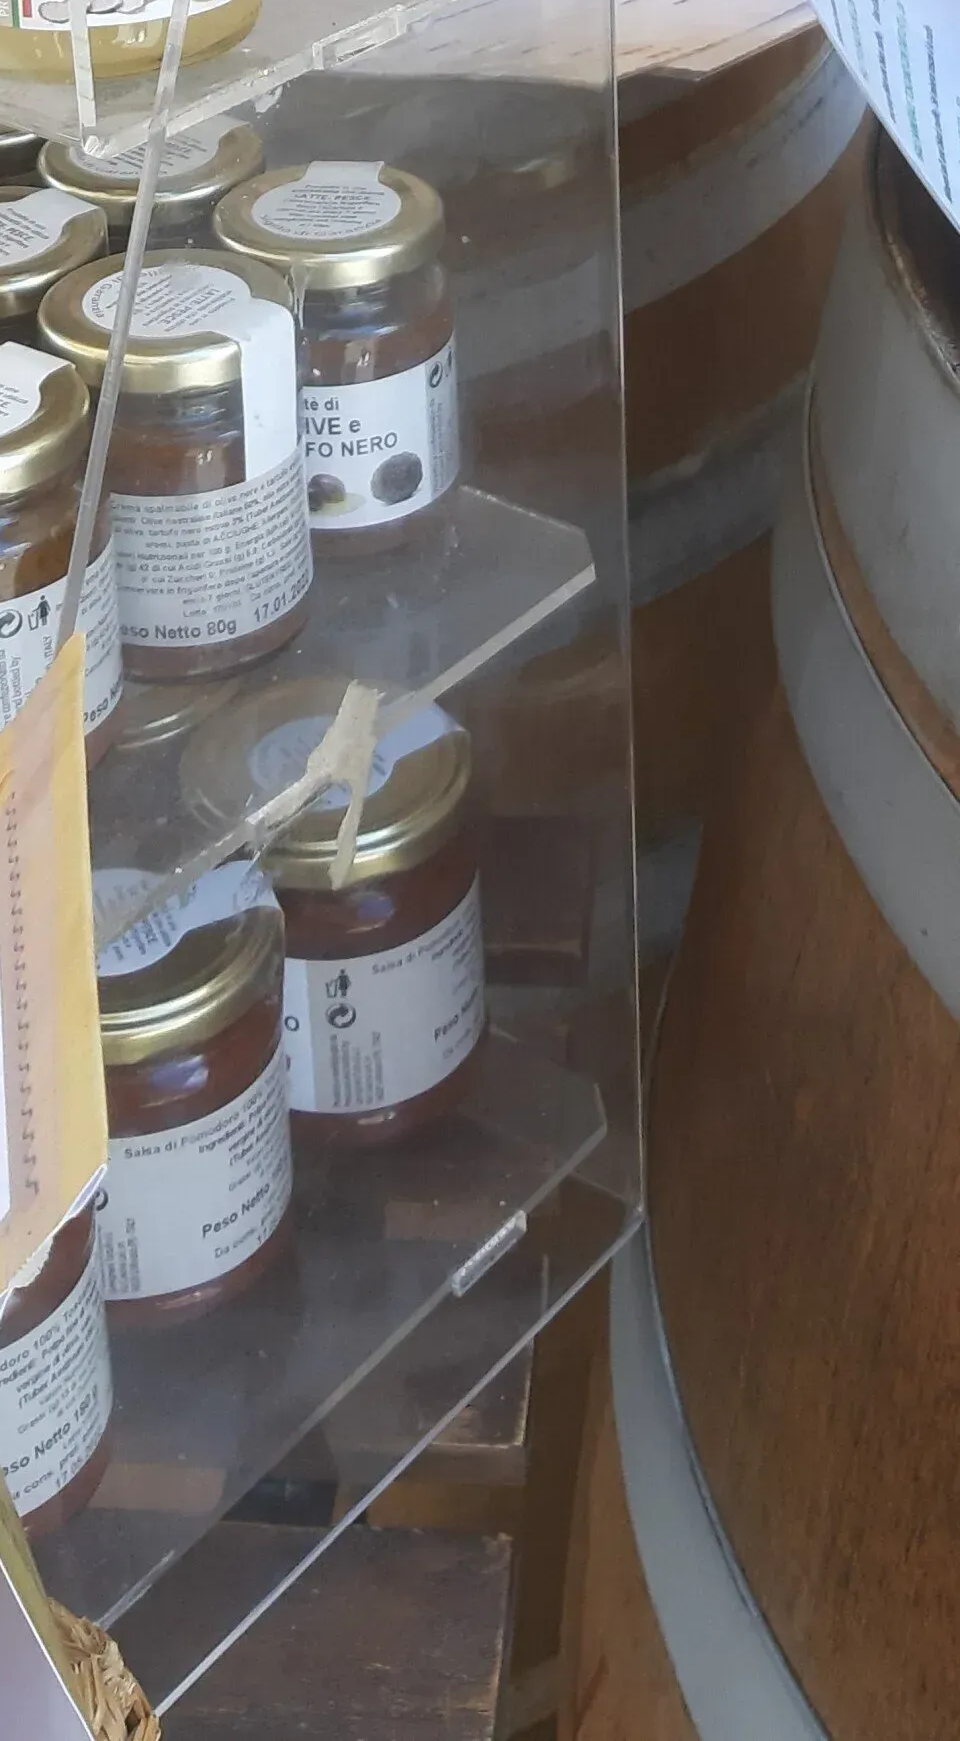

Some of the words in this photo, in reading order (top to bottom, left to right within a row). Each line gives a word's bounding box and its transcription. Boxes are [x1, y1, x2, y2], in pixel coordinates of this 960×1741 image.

[324, 396, 340, 411] di
[348, 419, 361, 433] e
[340, 432, 398, 458] NERO
[154, 623, 201, 640] Netto
[206, 618, 237, 636] 80g
[124, 1145, 161, 1159] Salsa
[164, 1140, 178, 1152] di
[180, 1110, 241, 1148] Pomodoro
[201, 1210, 238, 1239] Peso
[241, 1183, 271, 1217] Netto
[34, 1420, 72, 1461] Netto
